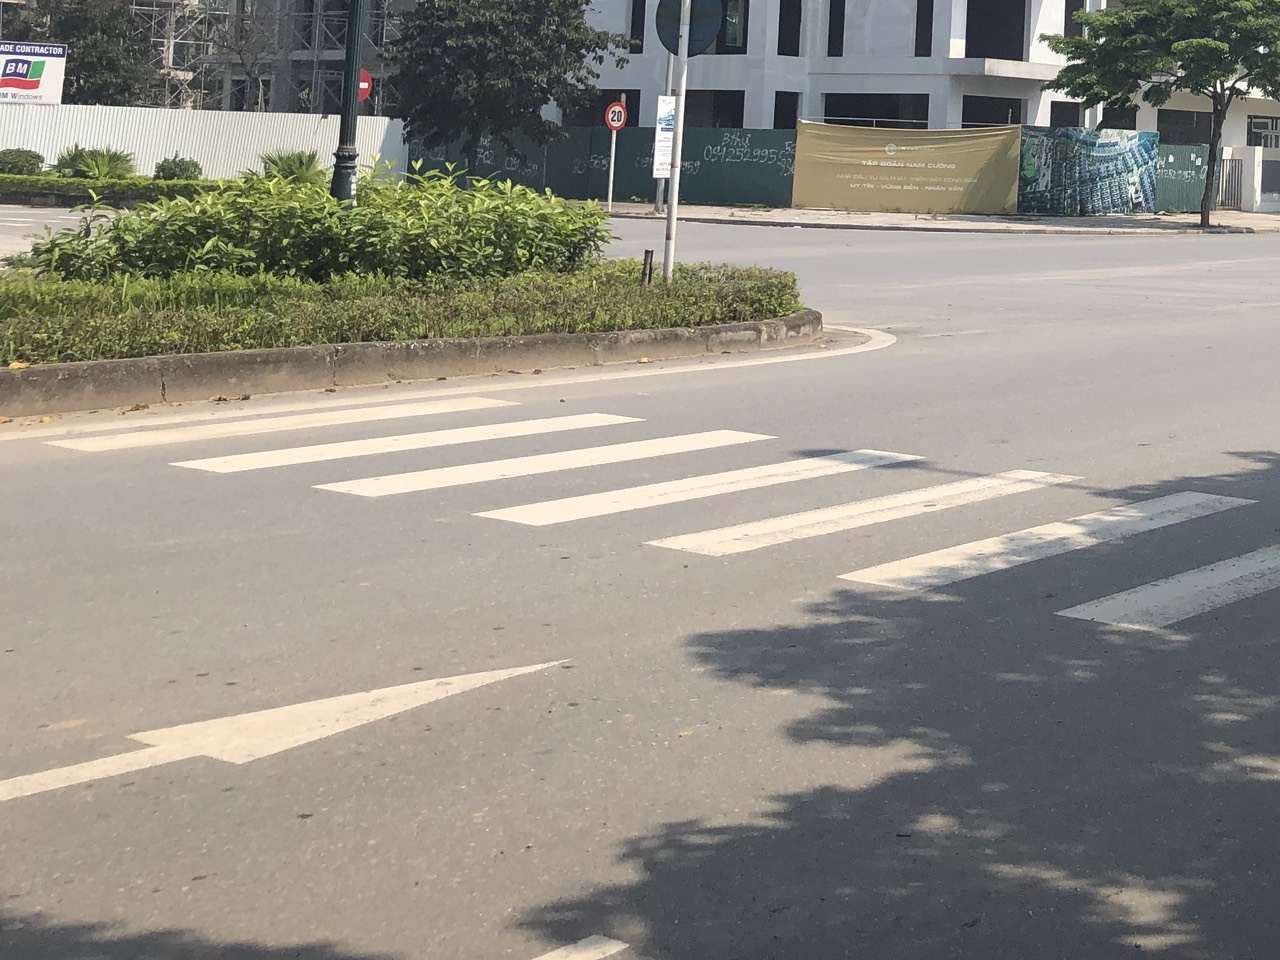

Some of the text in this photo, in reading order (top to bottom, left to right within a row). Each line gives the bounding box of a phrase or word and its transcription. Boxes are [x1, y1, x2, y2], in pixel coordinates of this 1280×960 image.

[0, 44, 63, 55] ADE CONTRACTOR
[5, 62, 28, 75] BM
[10, 92, 43, 101] Windows
[610, 110, 623, 122] 20
